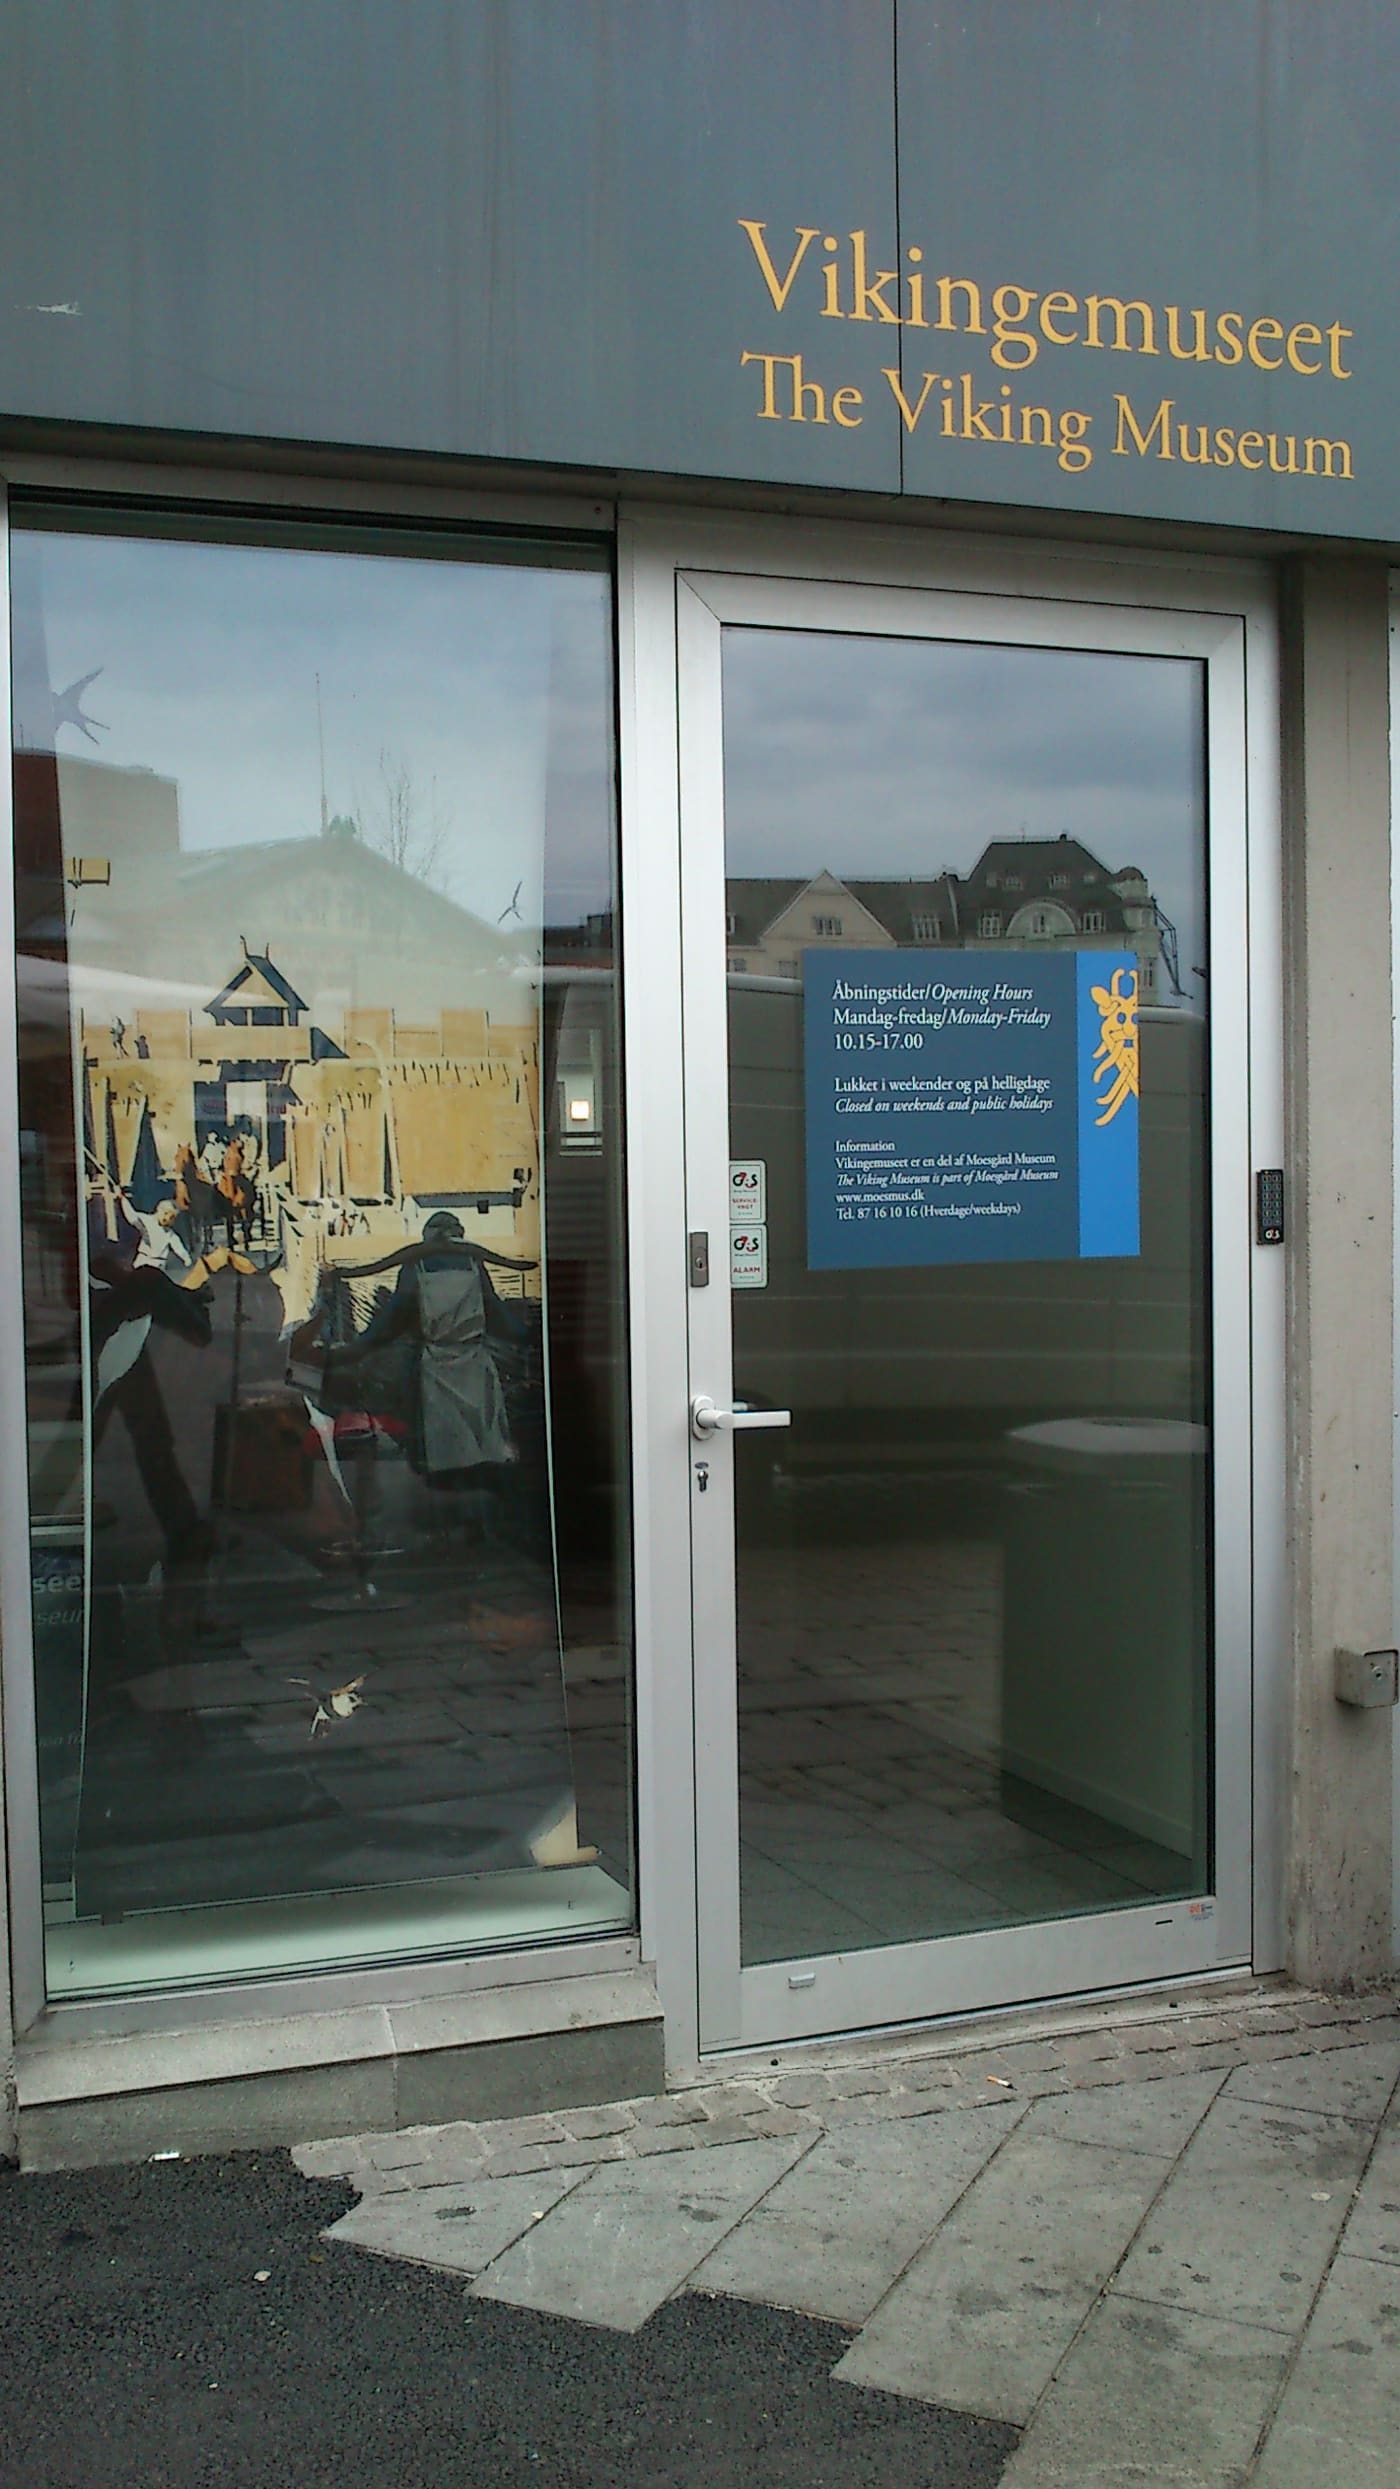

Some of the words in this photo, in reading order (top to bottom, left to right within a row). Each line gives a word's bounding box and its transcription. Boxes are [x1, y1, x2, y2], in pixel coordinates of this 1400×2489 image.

[738, 219, 1353, 379] Vikingemuseet
[742, 351, 863, 427] The
[882, 368, 1092, 472] Viking
[1111, 394, 1354, 479] Museum
[832, 979, 989, 1005] Åbningstider/Opening
[993, 983, 1033, 1000] Hours
[833, 1007, 1051, 1029] Mandag-fredag/Monday-Friday
[835, 1033, 924, 1050] 10.15-17.00
[835, 1076, 878, 1092] Lukket
[881, 1077, 886, 1091] i
[889, 1075, 953, 1091] weekender
[956, 1080, 972, 1095] og
[974, 1076, 989, 1094] på
[992, 1074, 1051, 1093] helligdage
[836, 1097, 874, 1113] Closed
[874, 1101, 890, 1112] on
[893, 1096, 945, 1112] weekends
[947, 1096, 970, 1110] and
[970, 1095, 1009, 1115] public
[1009, 1095, 1054, 1113] holidays
[836, 1140, 896, 1152] Information
[835, 1157, 909, 1172] Vikingemuseet
[910, 1159, 921, 1168] er
[922, 1159, 935, 1168] en
[936, 1154, 953, 1167] del
[953, 1153, 966, 1166] af
[966, 1153, 1013, 1169] Moesgård
[1014, 1152, 1057, 1165] Museum
[838, 1174, 855, 1186] The
[857, 1173, 888, 1188] Viking
[889, 1173, 931, 1185] Museum
[932, 1173, 940, 1184] is
[940, 1173, 962, 1187] part
[963, 1170, 976, 1186] of
[975, 1170, 1020, 1185] Moesgård
[1020, 1169, 1060, 1181] Museum
[836, 1188, 925, 1202] www.moesmus.dk
[836, 1207, 855, 1220] Tel.
[857, 1207, 871, 1219] 87
[874, 1207, 888, 1218] 16
[890, 1206, 903, 1218] 10
[906, 1206, 919, 1217] 16
[920, 1202, 1022, 1219] (Hverdage/weekdays)
[733, 1266, 761, 1274] ALARM
